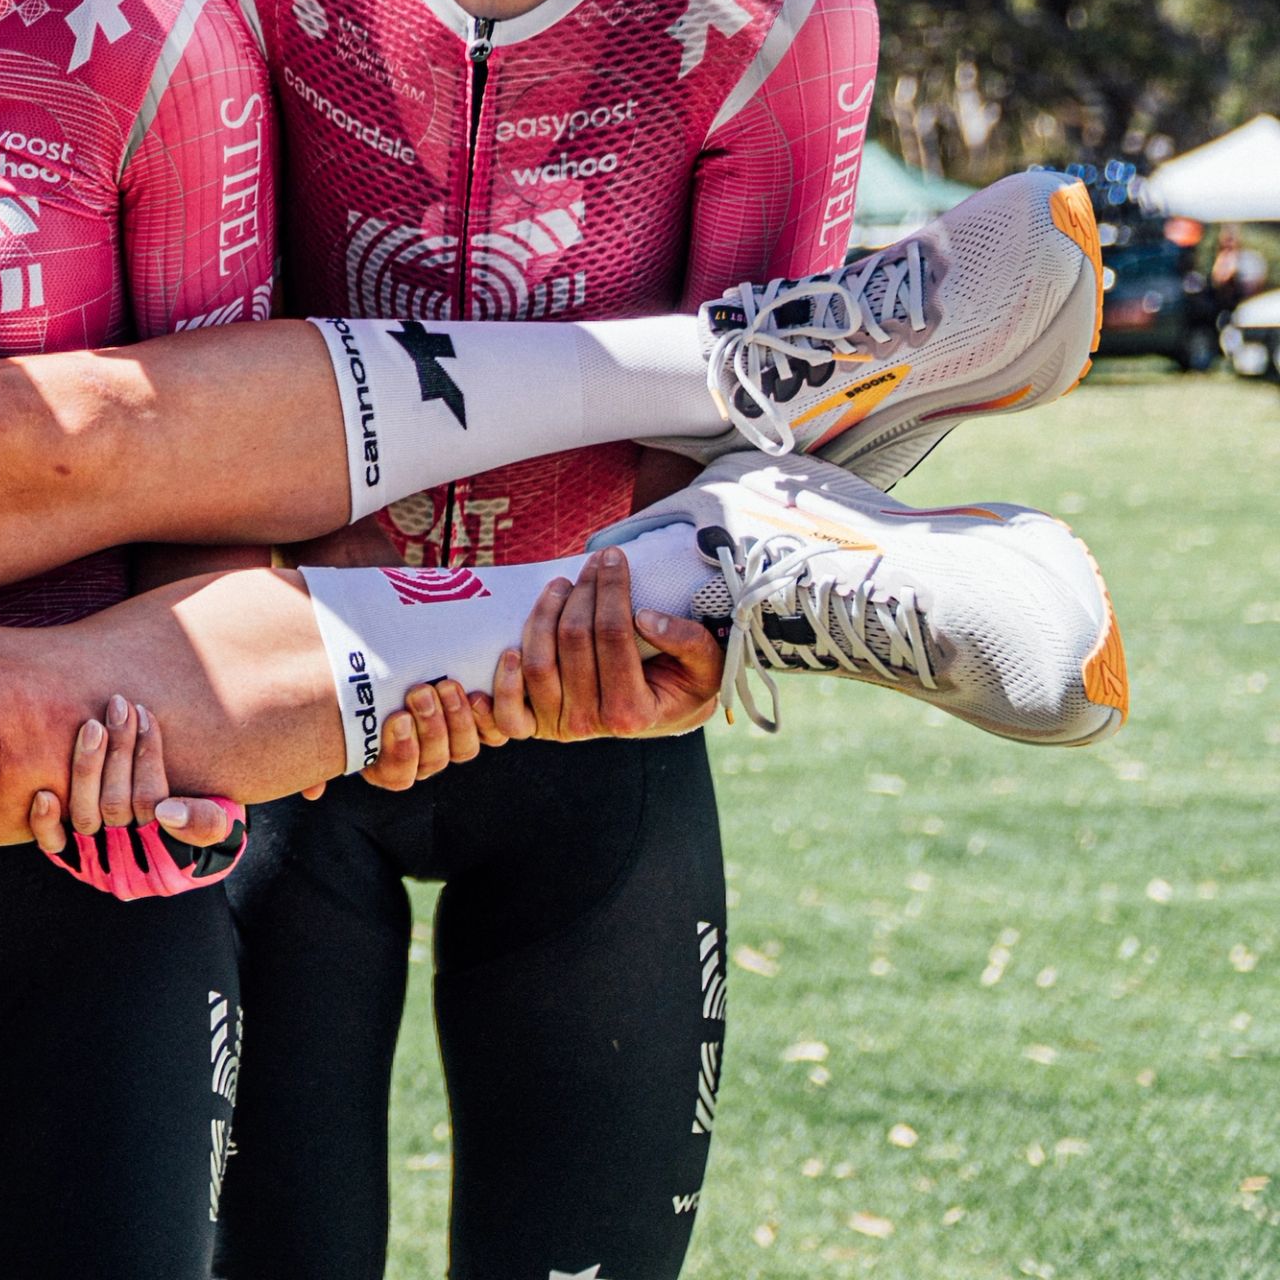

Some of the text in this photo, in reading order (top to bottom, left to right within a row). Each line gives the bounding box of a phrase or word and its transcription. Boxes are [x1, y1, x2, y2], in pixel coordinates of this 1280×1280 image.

[284, 67, 416, 166] cannondale
[496, 97, 640, 144] easypost
[219, 93, 264, 278] STIFEL
[512, 150, 619, 187] wahoo
[818, 78, 876, 248] STIFEL
[845, 372, 896, 399] BROOKS
